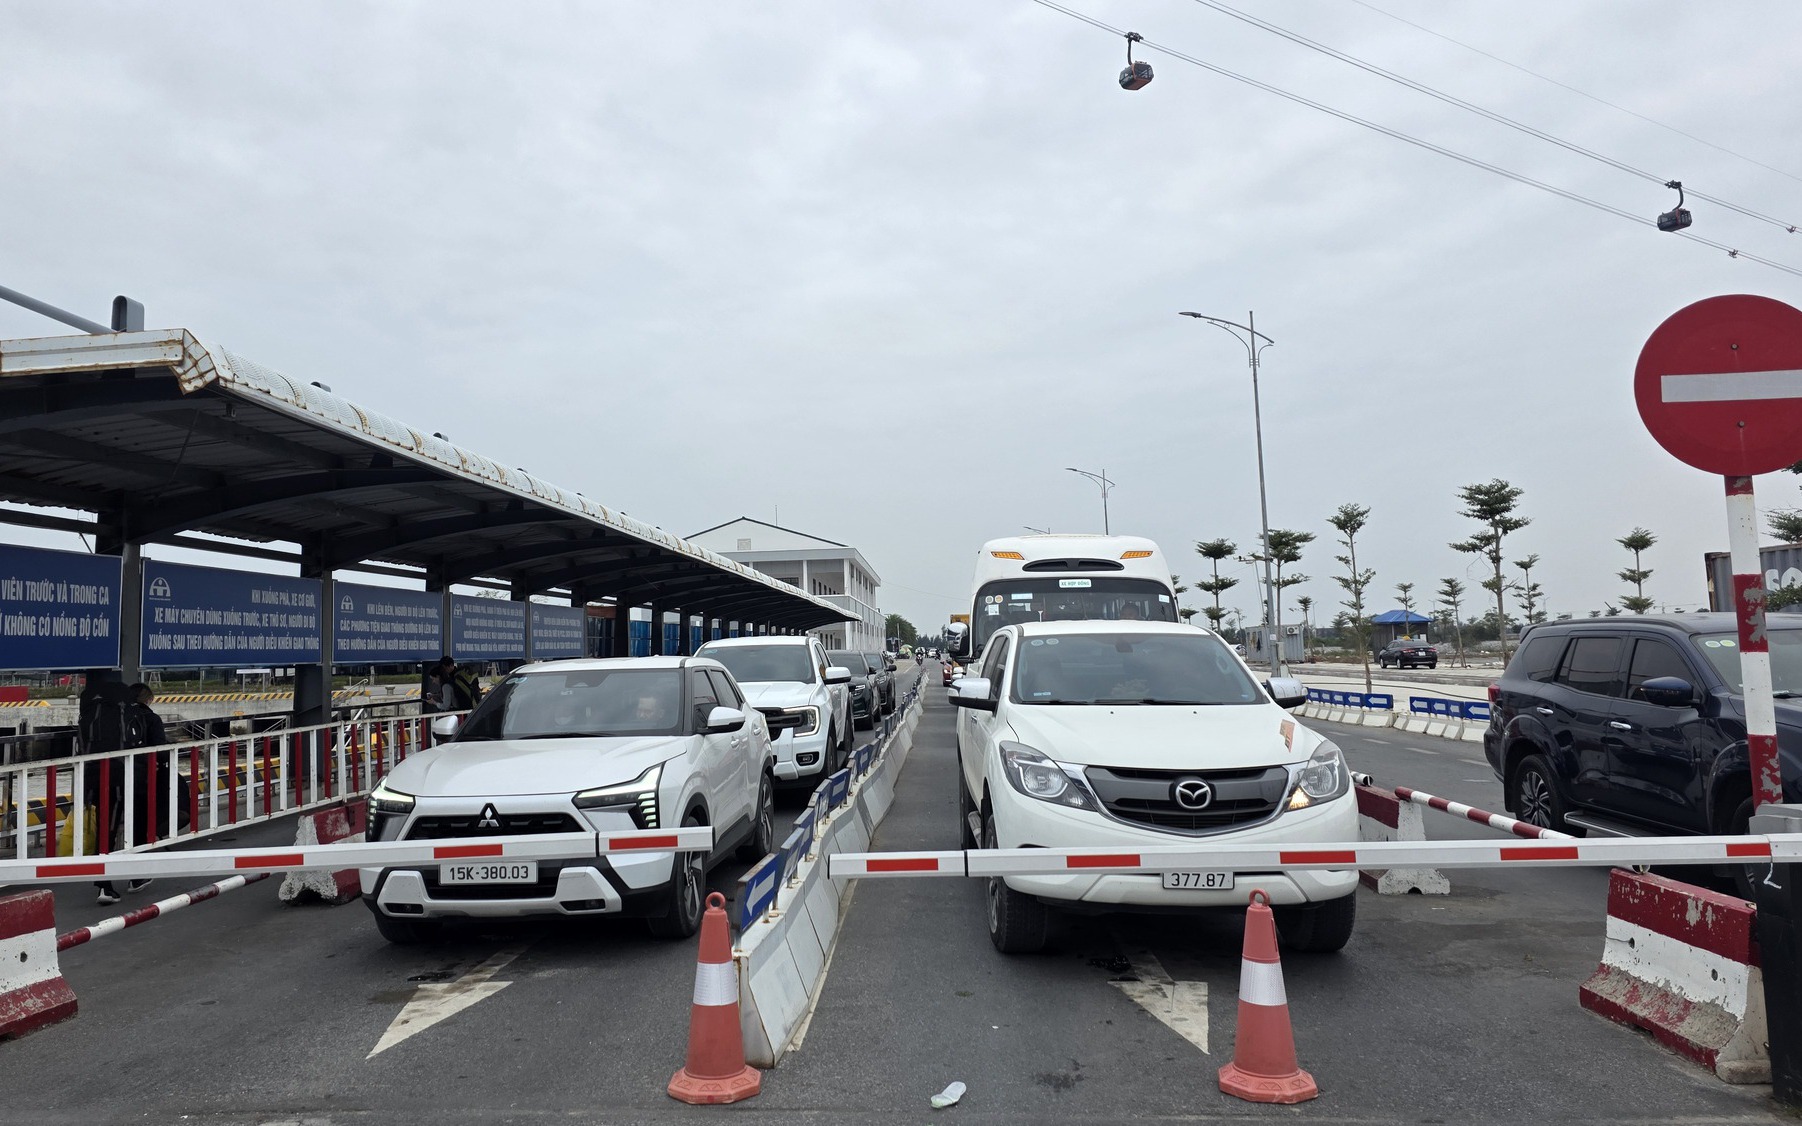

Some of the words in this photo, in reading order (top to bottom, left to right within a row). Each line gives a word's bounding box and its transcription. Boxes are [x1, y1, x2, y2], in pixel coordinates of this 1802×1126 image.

[2, 576, 23, 600] VIÊN
[25, 578, 54, 602] TRƯỚC
[56, 580, 68, 603] VÀ
[70, 584, 97, 604] TRONG
[99, 586, 109, 605] CA
[154, 607, 164, 623] XE
[164, 605, 179, 623] MÁY
[180, 606, 205, 624] CHUYÊN
[4, 611, 36, 636] KHÔNG
[38, 613, 50, 637] CÓ
[79, 614, 91, 640] ĐỘ
[148, 628, 172, 649] XUỐNG
[172, 634, 186, 650] SAU
[186, 635, 202, 650] THEO
[202, 631, 223, 650] HƯỚNG
[224, 630, 236, 650] DẪN
[450, 865, 529, 880] 15K-380.03
[1171, 872, 1226, 887] 377.87
